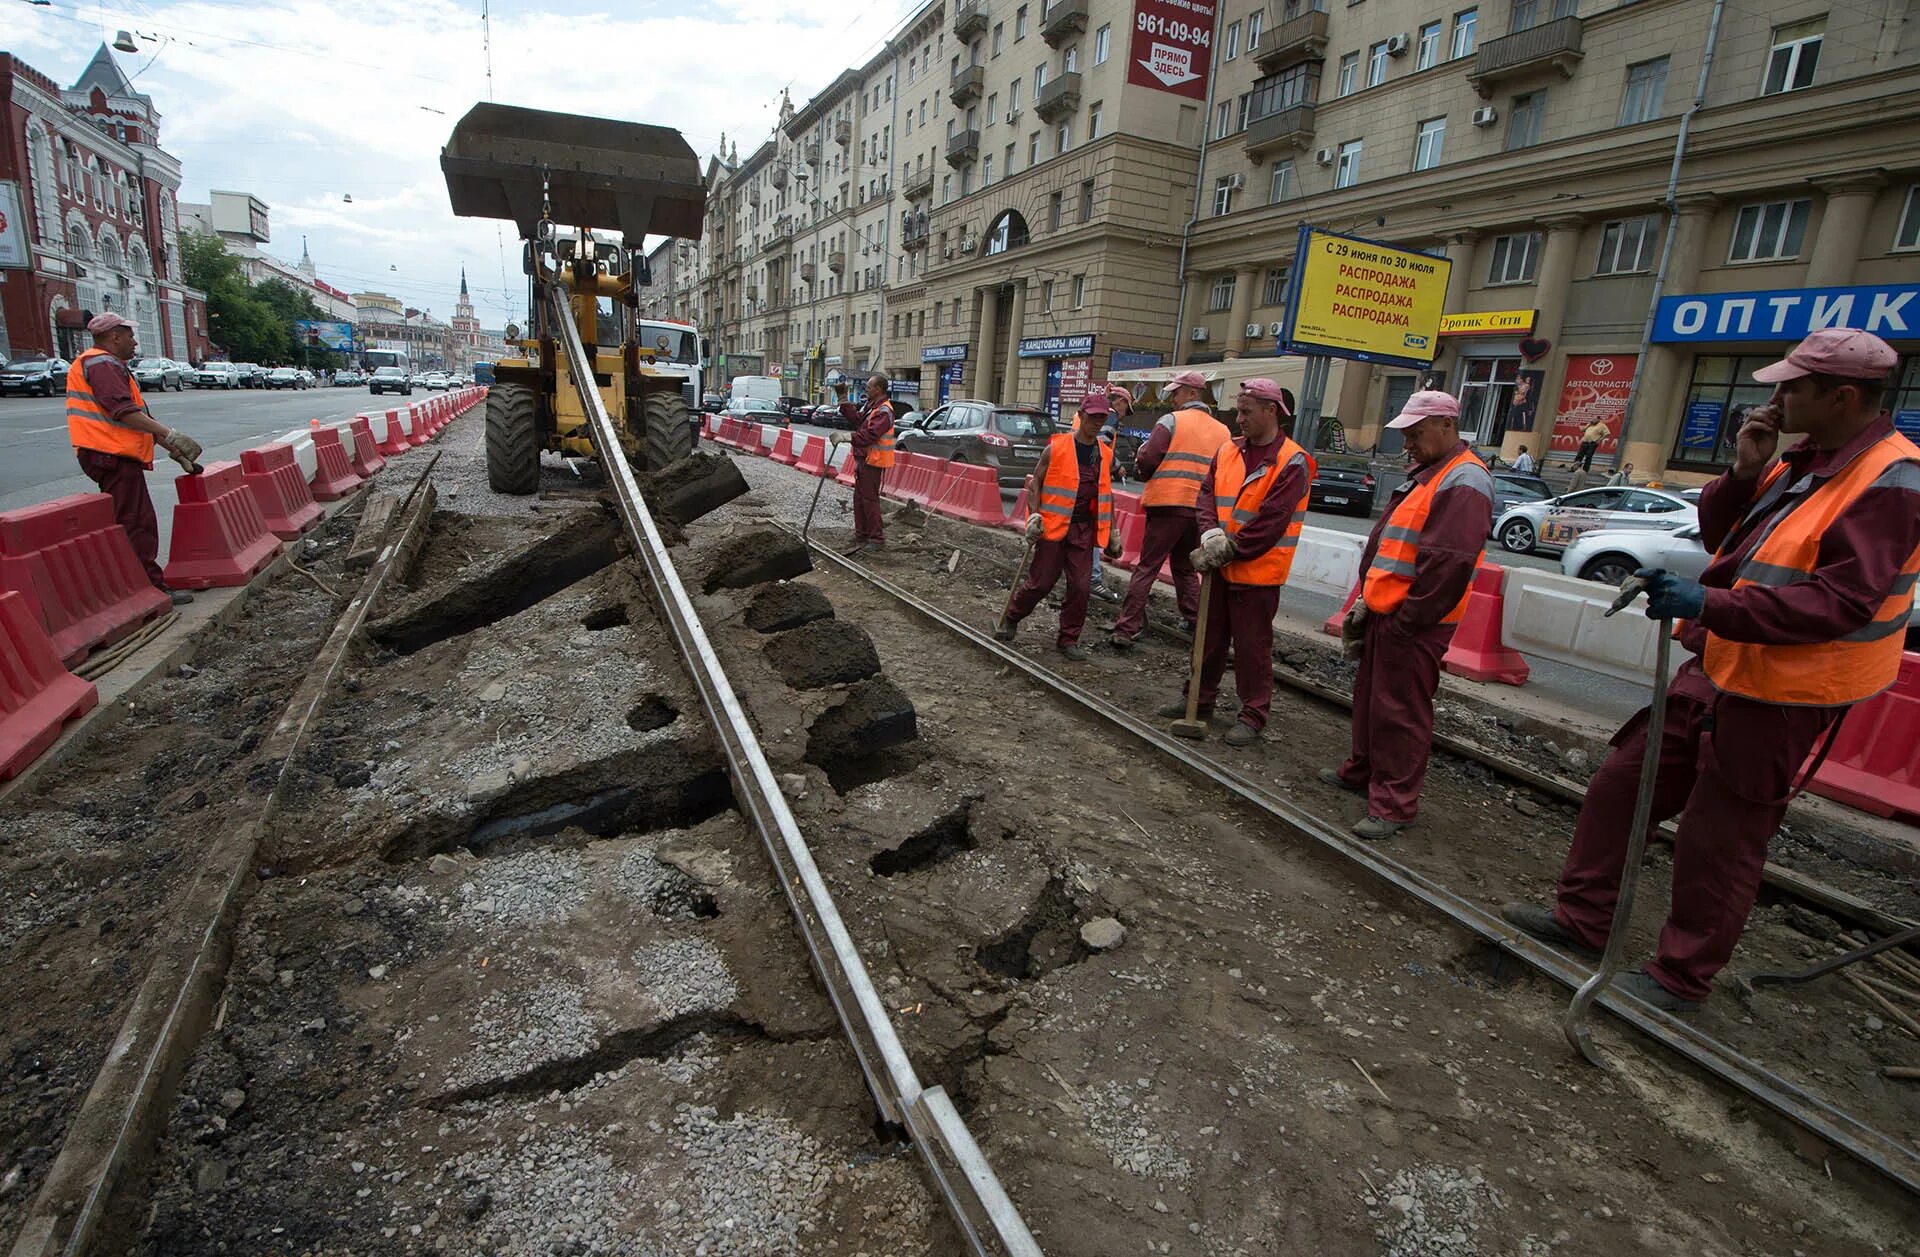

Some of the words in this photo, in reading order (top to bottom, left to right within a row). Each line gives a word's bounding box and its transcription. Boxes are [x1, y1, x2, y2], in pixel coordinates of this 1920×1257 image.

[1137, 12, 1210, 48] 961-09-94
[1154, 48, 1188, 65] ПРЯМО
[1154, 61, 1185, 77] ЗДЕСЬ
[1326, 242, 1334, 253] С
[1336, 244, 1348, 256] 29
[1351, 249, 1377, 263] июня
[1380, 254, 1392, 266] по
[1394, 257, 1407, 269] 30
[1409, 262, 1435, 275] июля
[1339, 263, 1417, 290] РАСПРОДАЖА
[1335, 283, 1413, 309] РАСПРОДАЖА
[1332, 302, 1409, 327] РАСПРОДАЖА
[1440, 317, 1483, 330] Эротик
[1490, 315, 1521, 326] Сити
[1673, 292, 1918, 335] ОПТИК
[1025, 338, 1065, 350] КАНЦТОВАРЫ
[1069, 336, 1092, 347] КНИГИ
[1567, 380, 1632, 389] АВТОЗАПЧАСТИ
[1552, 434, 1619, 449] TOYTA
